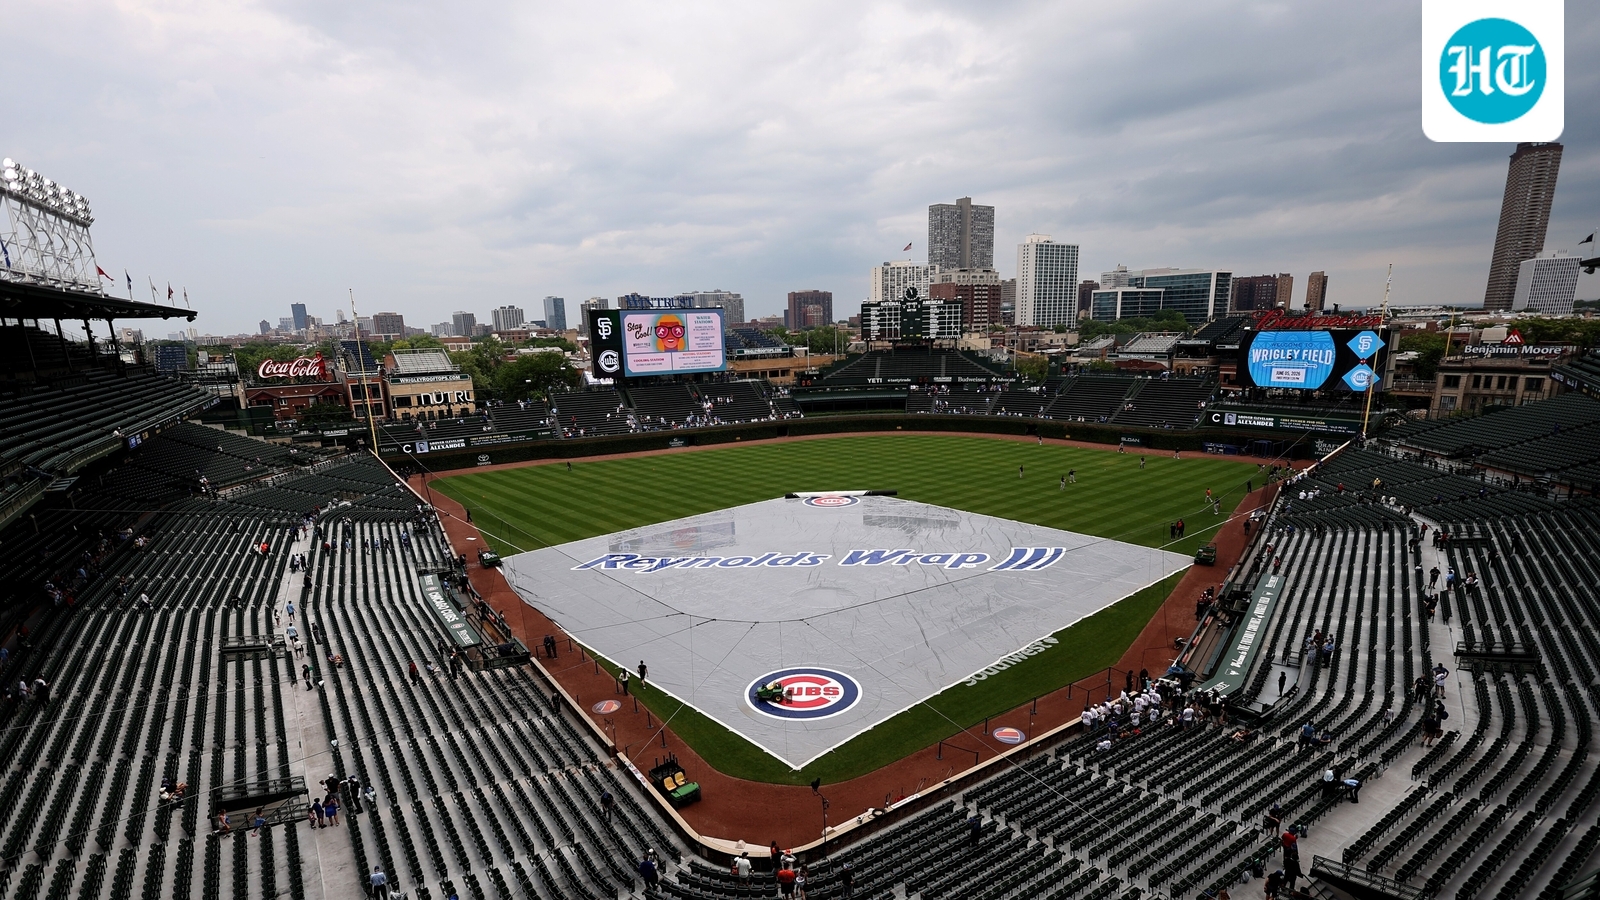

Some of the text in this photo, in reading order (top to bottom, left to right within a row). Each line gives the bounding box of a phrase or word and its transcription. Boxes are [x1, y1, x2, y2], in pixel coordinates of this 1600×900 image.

[625, 294, 694, 309] WINTRUST
[627, 322, 642, 332] Stay
[1252, 309, 1384, 330] Budweiser
[597, 318, 612, 339] SF
[635, 326, 652, 339] Cool!
[1252, 349, 1332, 365] WRIGLEY FIELD
[1464, 345, 1561, 355] Benjamin Moore
[258, 357, 321, 378] Coca-Cola
[1212, 414, 1220, 422] C
[403, 444, 412, 453] C
[430, 443, 465, 451] ALEXANDER
[571, 550, 990, 574] Reynolds Wrap
[428, 591, 450, 610] CHICAGO
[440, 608, 459, 623] CUBS
